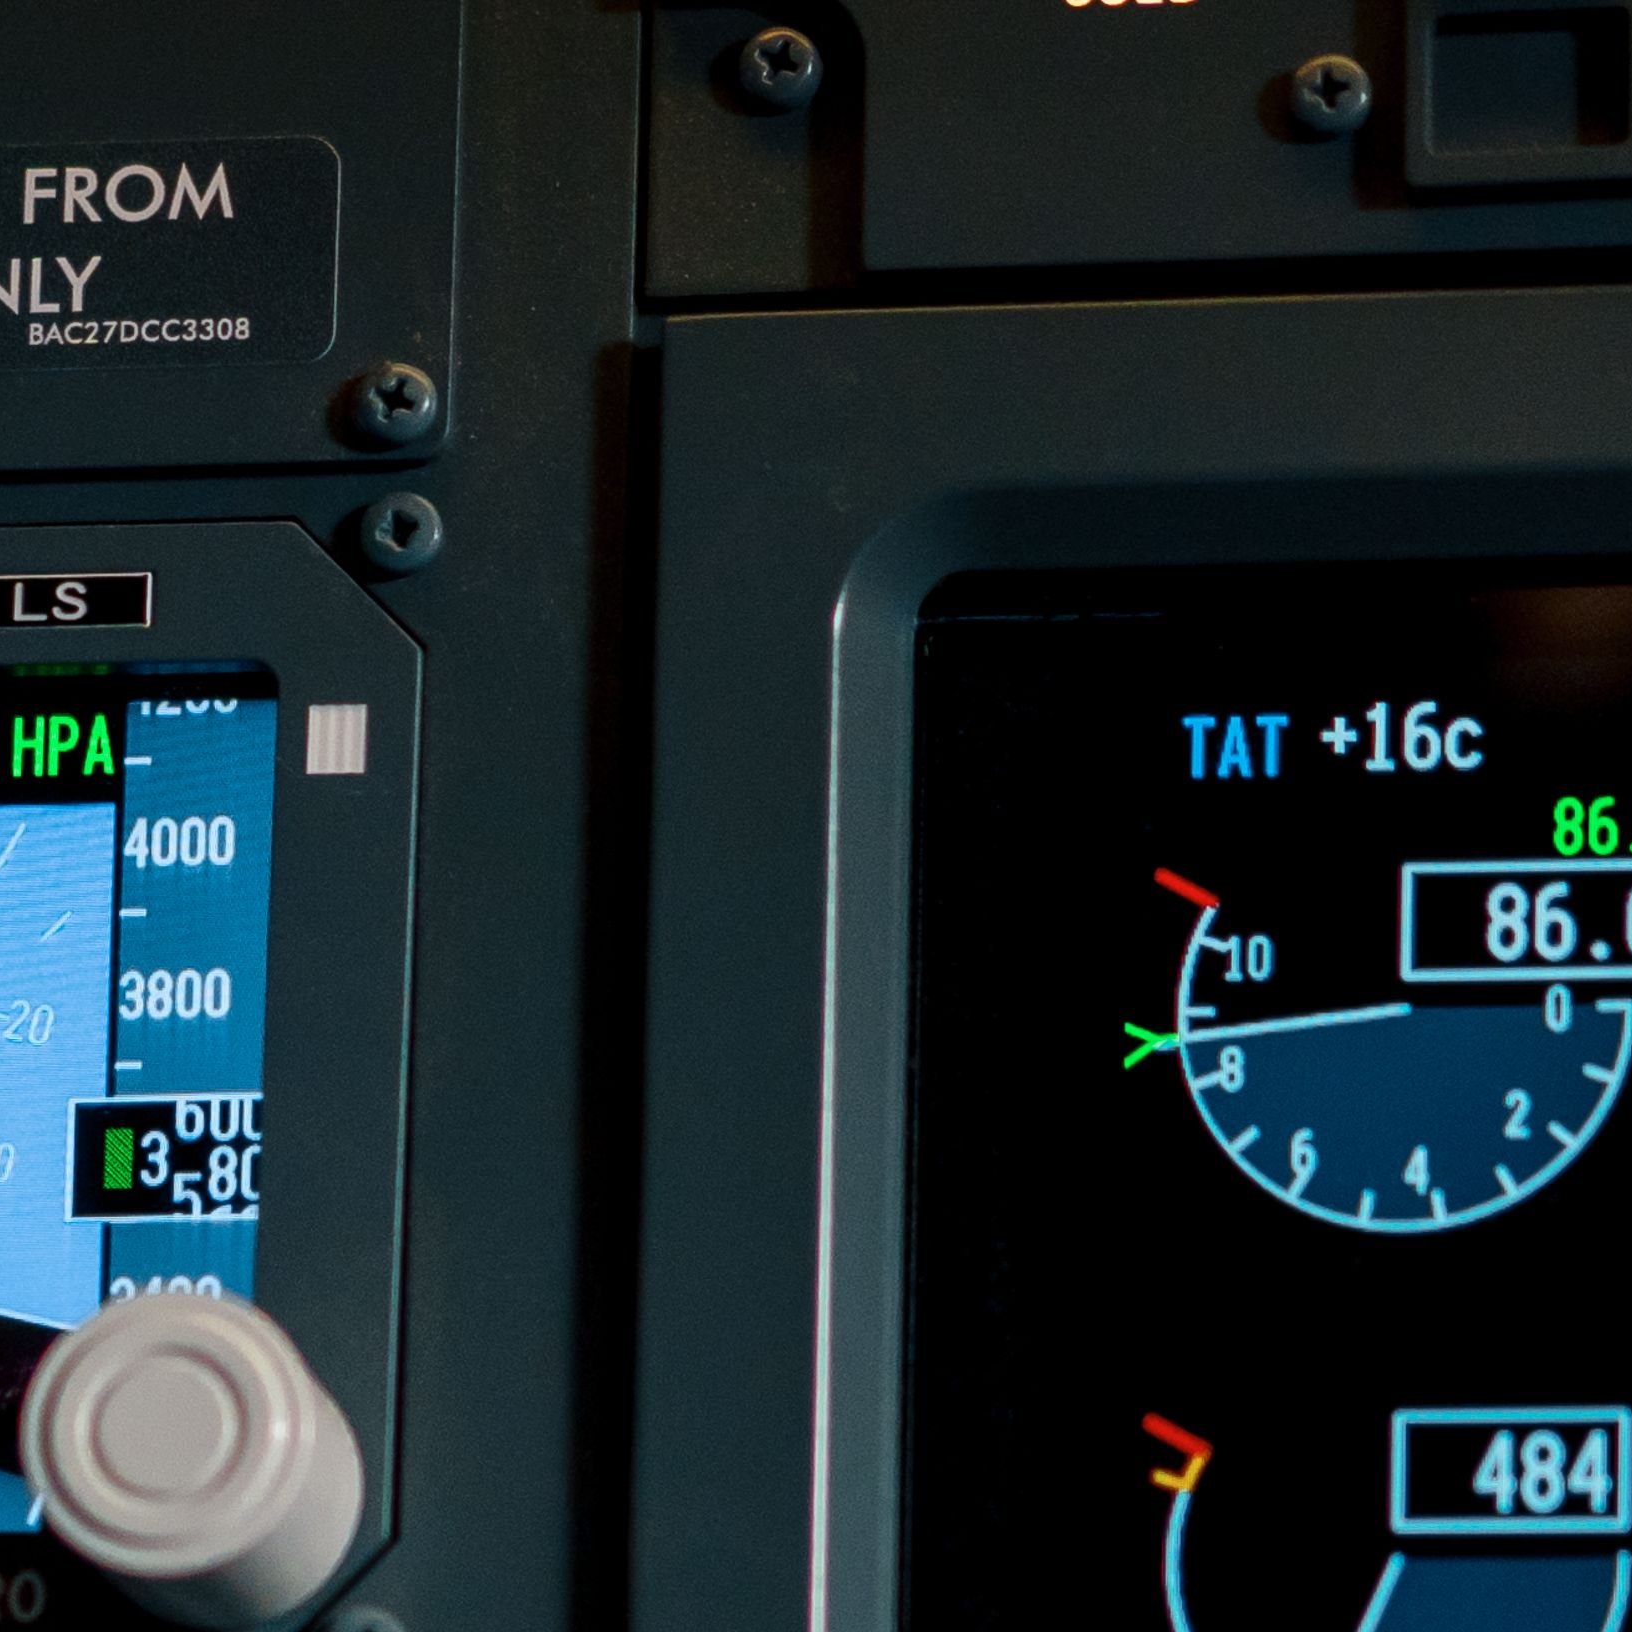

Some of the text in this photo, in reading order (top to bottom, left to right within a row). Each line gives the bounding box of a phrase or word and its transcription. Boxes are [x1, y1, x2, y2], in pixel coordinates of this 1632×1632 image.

[23, 162, 234, 225] FROM
[28, 316, 250, 346] BAC27DCC3308
[12, 581, 88, 622] LS
[11, 713, 115, 778] HPA
[1181, 700, 1484, 780] TAT +16c
[123, 815, 236, 869] 4000
[1224, 934, 1274, 983] 10
[119, 967, 231, 1022] 3800
[1544, 983, 1571, 1033] 0
[3, 1000, 55, 1046] 20
[1219, 1044, 1246, 1093] 8
[1504, 1088, 1532, 1141] 2
[1290, 1127, 1318, 1178] 6
[1403, 1144, 1431, 1195] 4
[1472, 1428, 1613, 1515] 484
